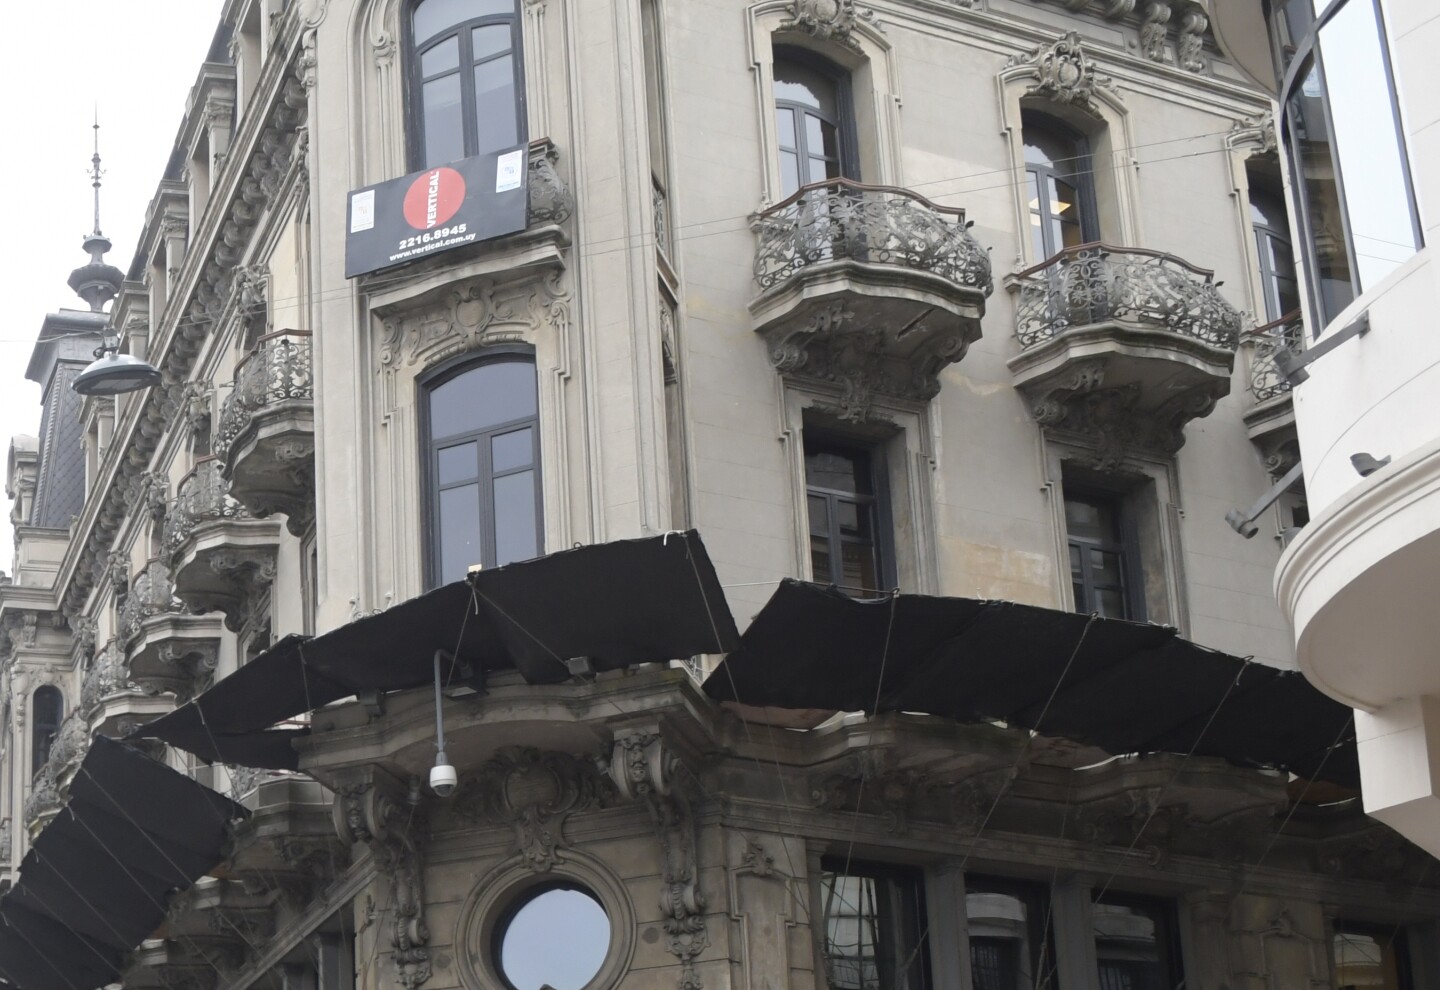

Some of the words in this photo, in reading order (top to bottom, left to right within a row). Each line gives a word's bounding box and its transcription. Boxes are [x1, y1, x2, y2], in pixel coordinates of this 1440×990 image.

[426, 170, 440, 229] VERTICAL
[389, 233, 476, 261] www.vertical.com.uy
[398, 223, 467, 250] 2216.8945
